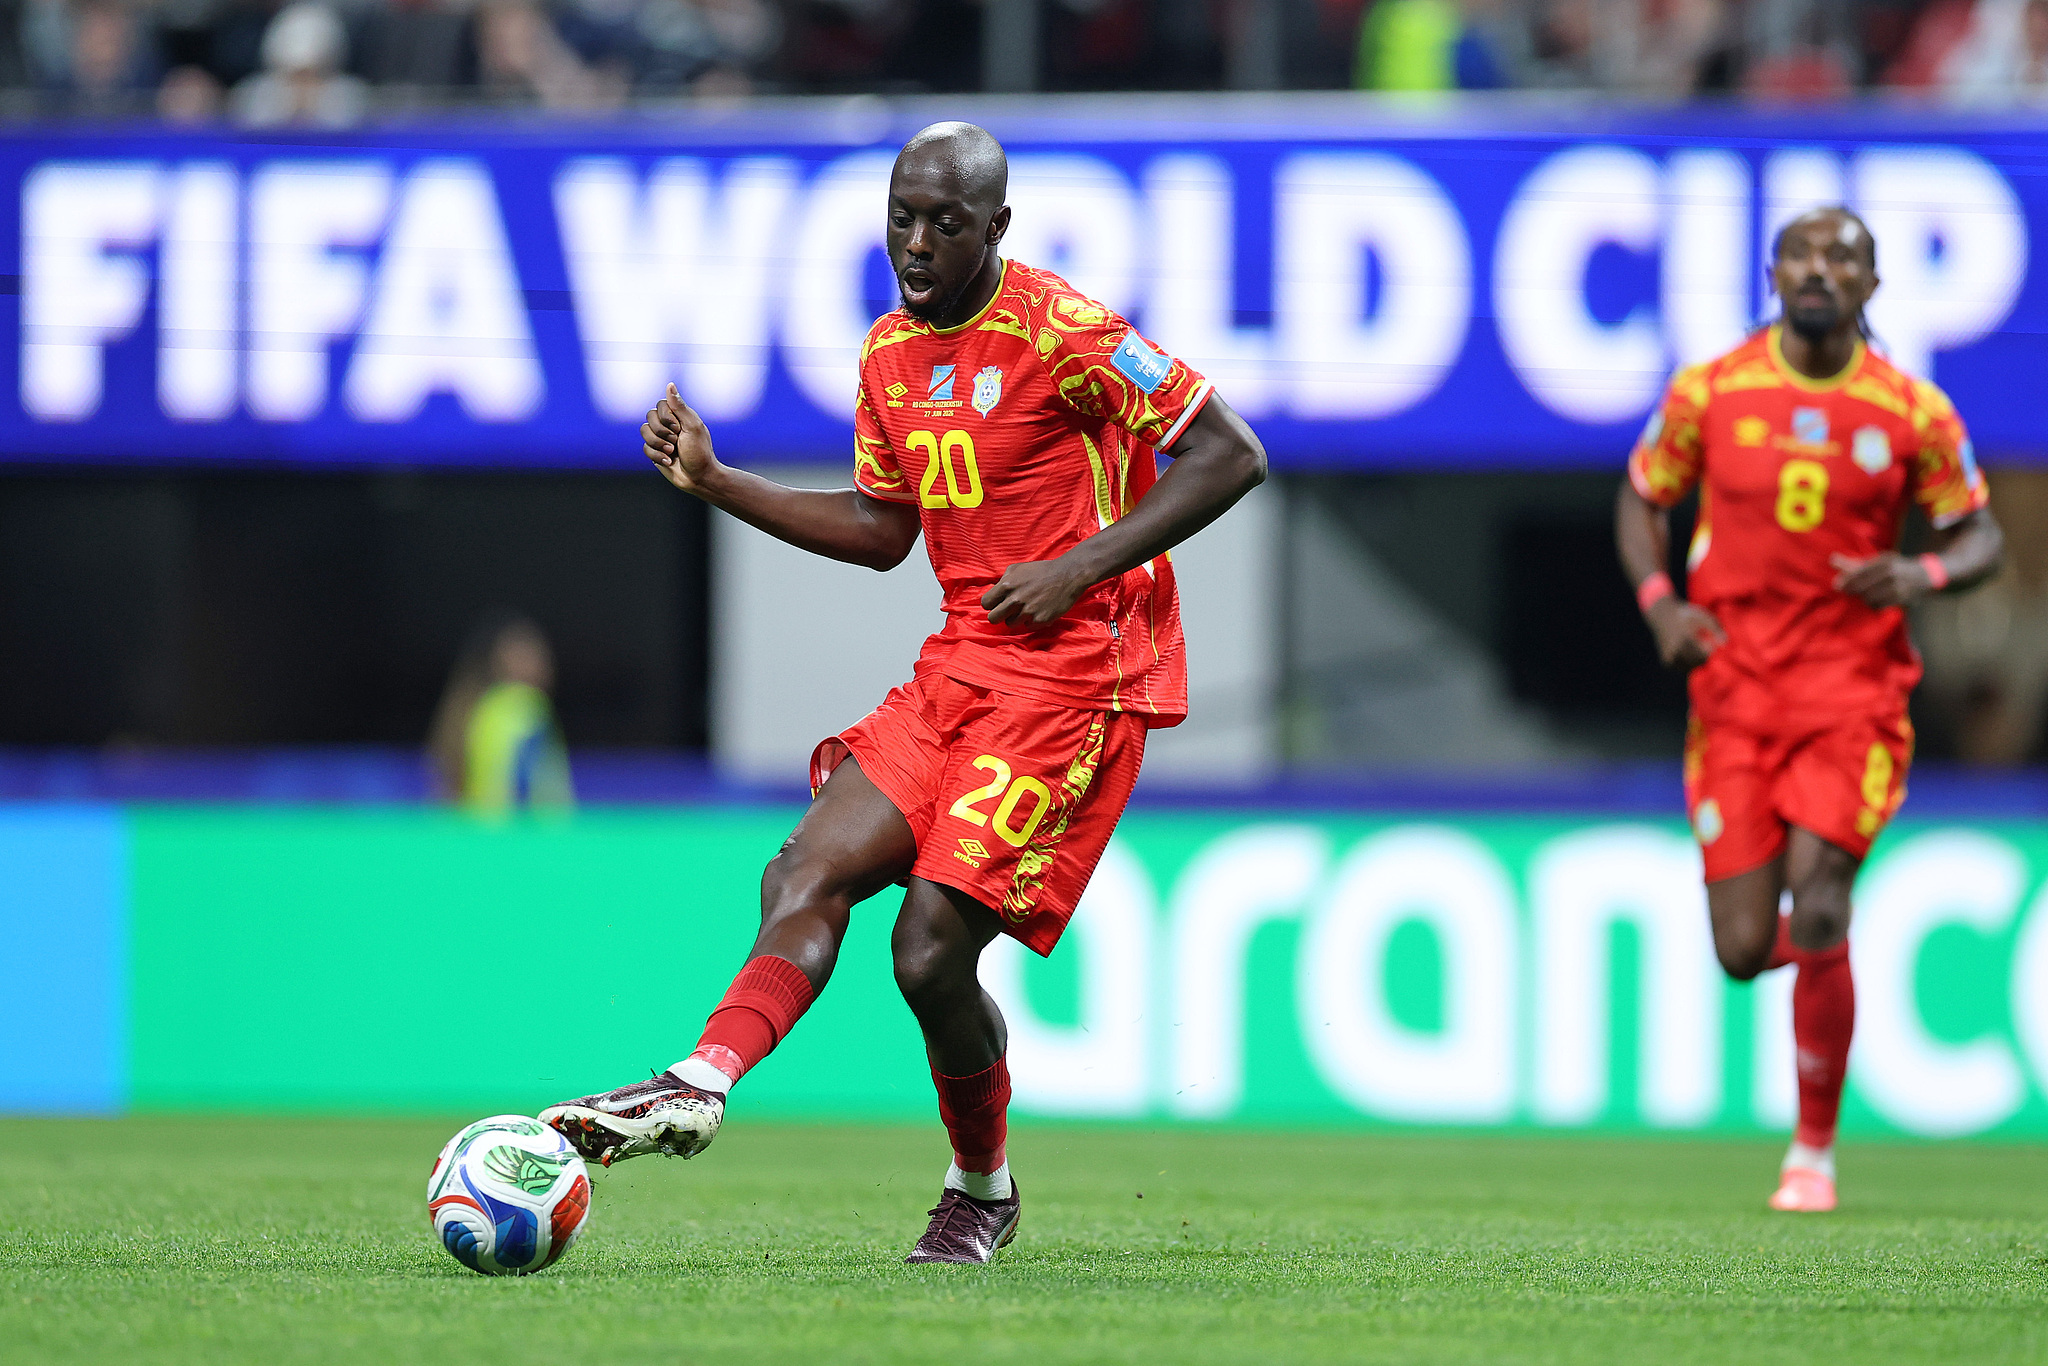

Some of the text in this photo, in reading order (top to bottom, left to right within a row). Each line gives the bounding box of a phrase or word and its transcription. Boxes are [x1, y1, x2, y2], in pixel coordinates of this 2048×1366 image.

[20, 158, 547, 424] FIFA
[942, 409, 954, 417] 2026
[905, 429, 984, 509] 20
[1775, 459, 1830, 533] 8
[948, 754, 1051, 848] 20
[1861, 740, 1894, 811] 8
[953, 850, 980, 869] umbro
[976, 824, 2048, 1136] aramc
